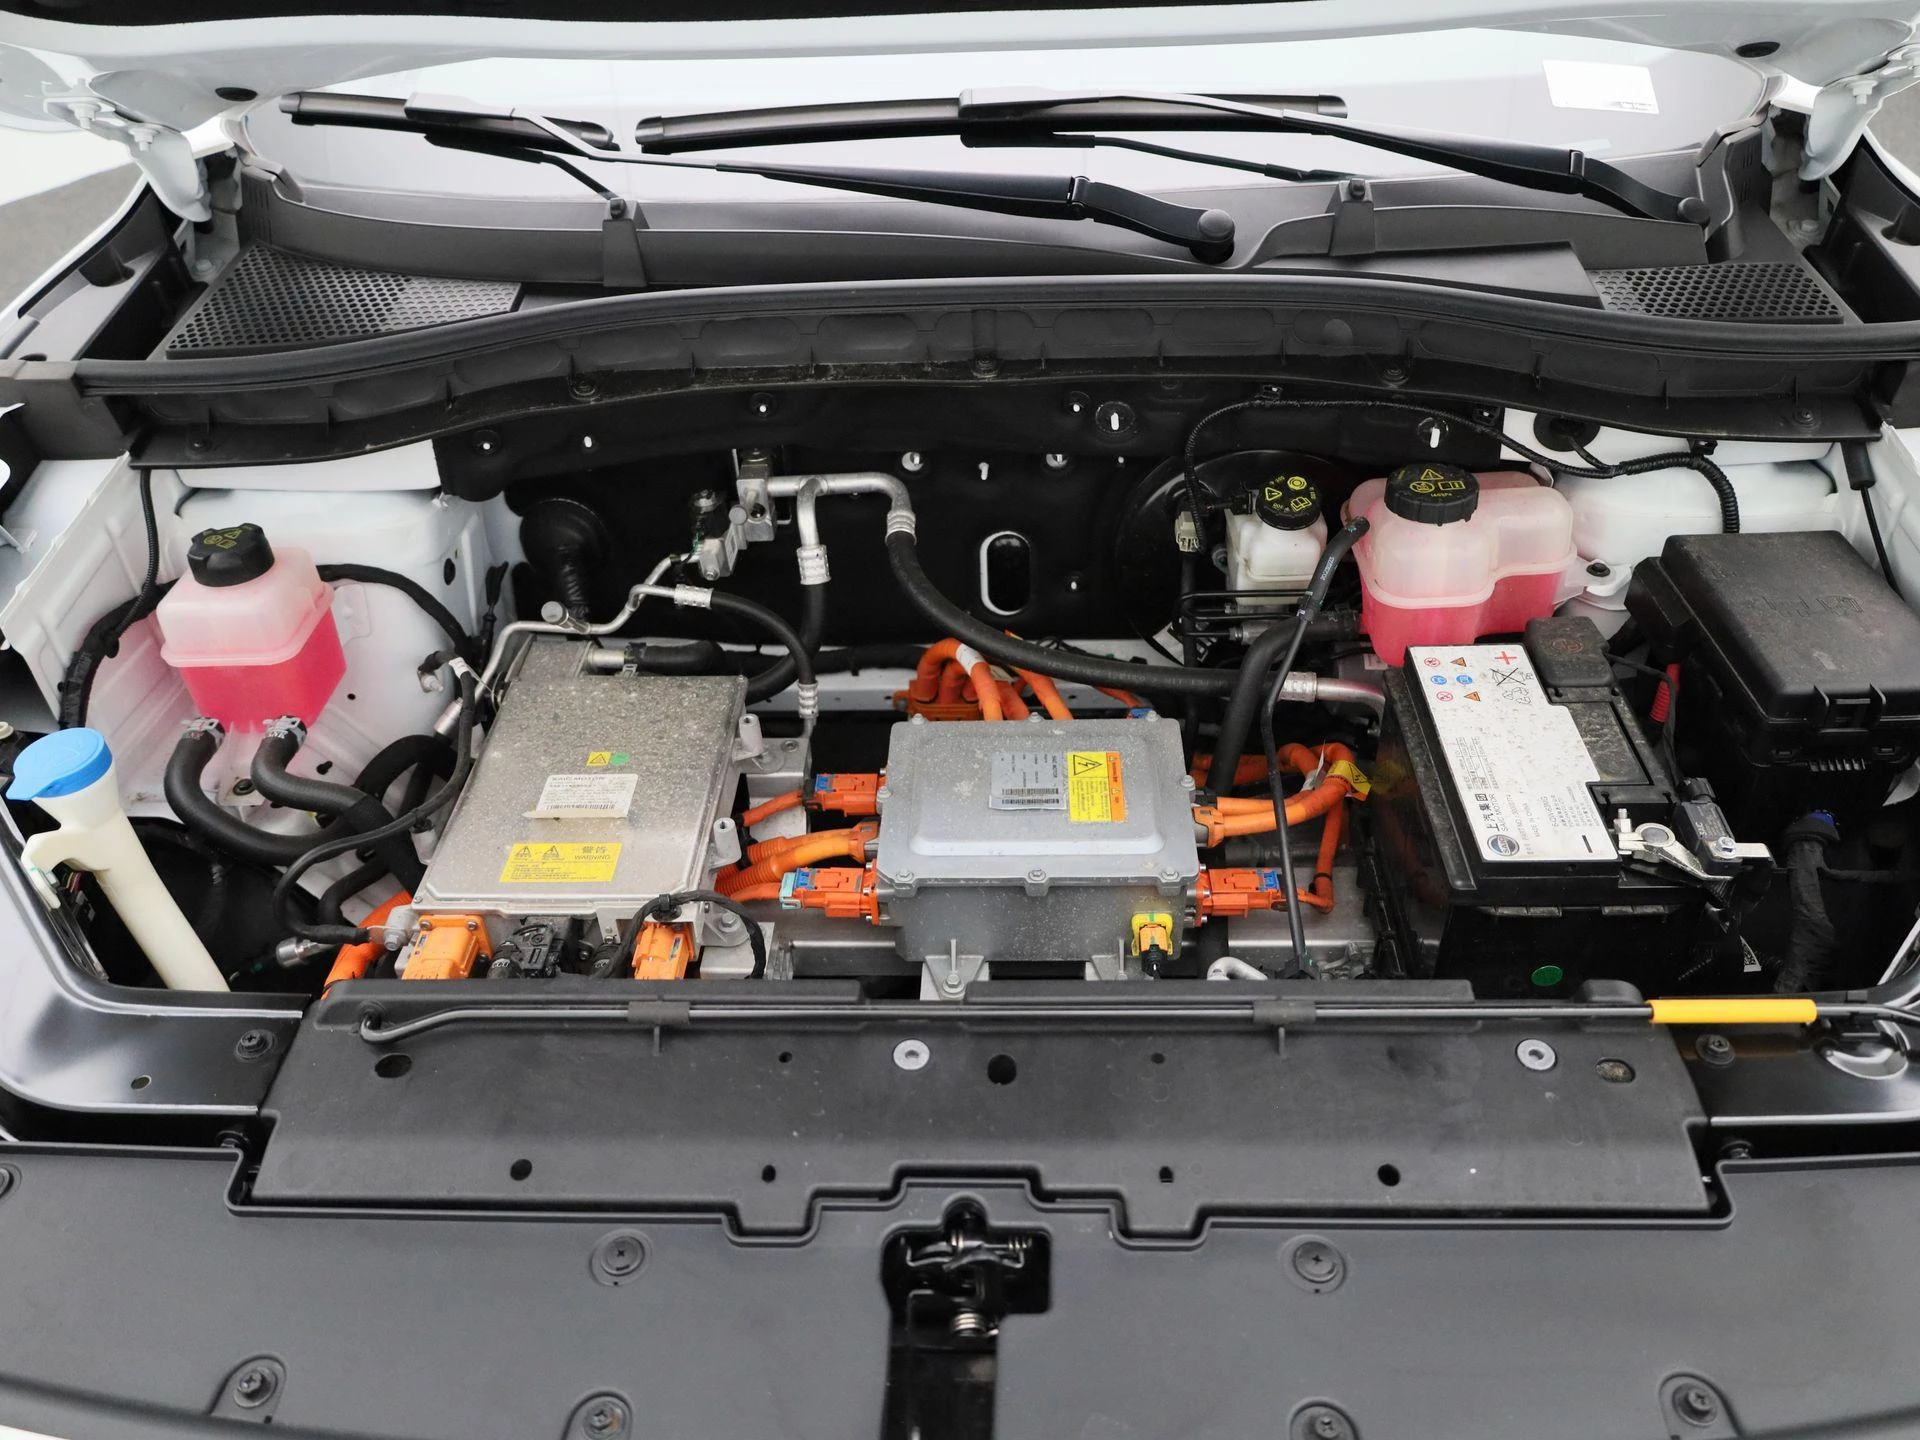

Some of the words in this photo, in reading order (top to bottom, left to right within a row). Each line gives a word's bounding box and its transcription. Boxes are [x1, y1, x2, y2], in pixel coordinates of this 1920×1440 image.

[1475, 793, 1500, 832] 上汽集团
[1488, 793, 1503, 816] MOTOR
[1498, 835, 1511, 855] SAIC
